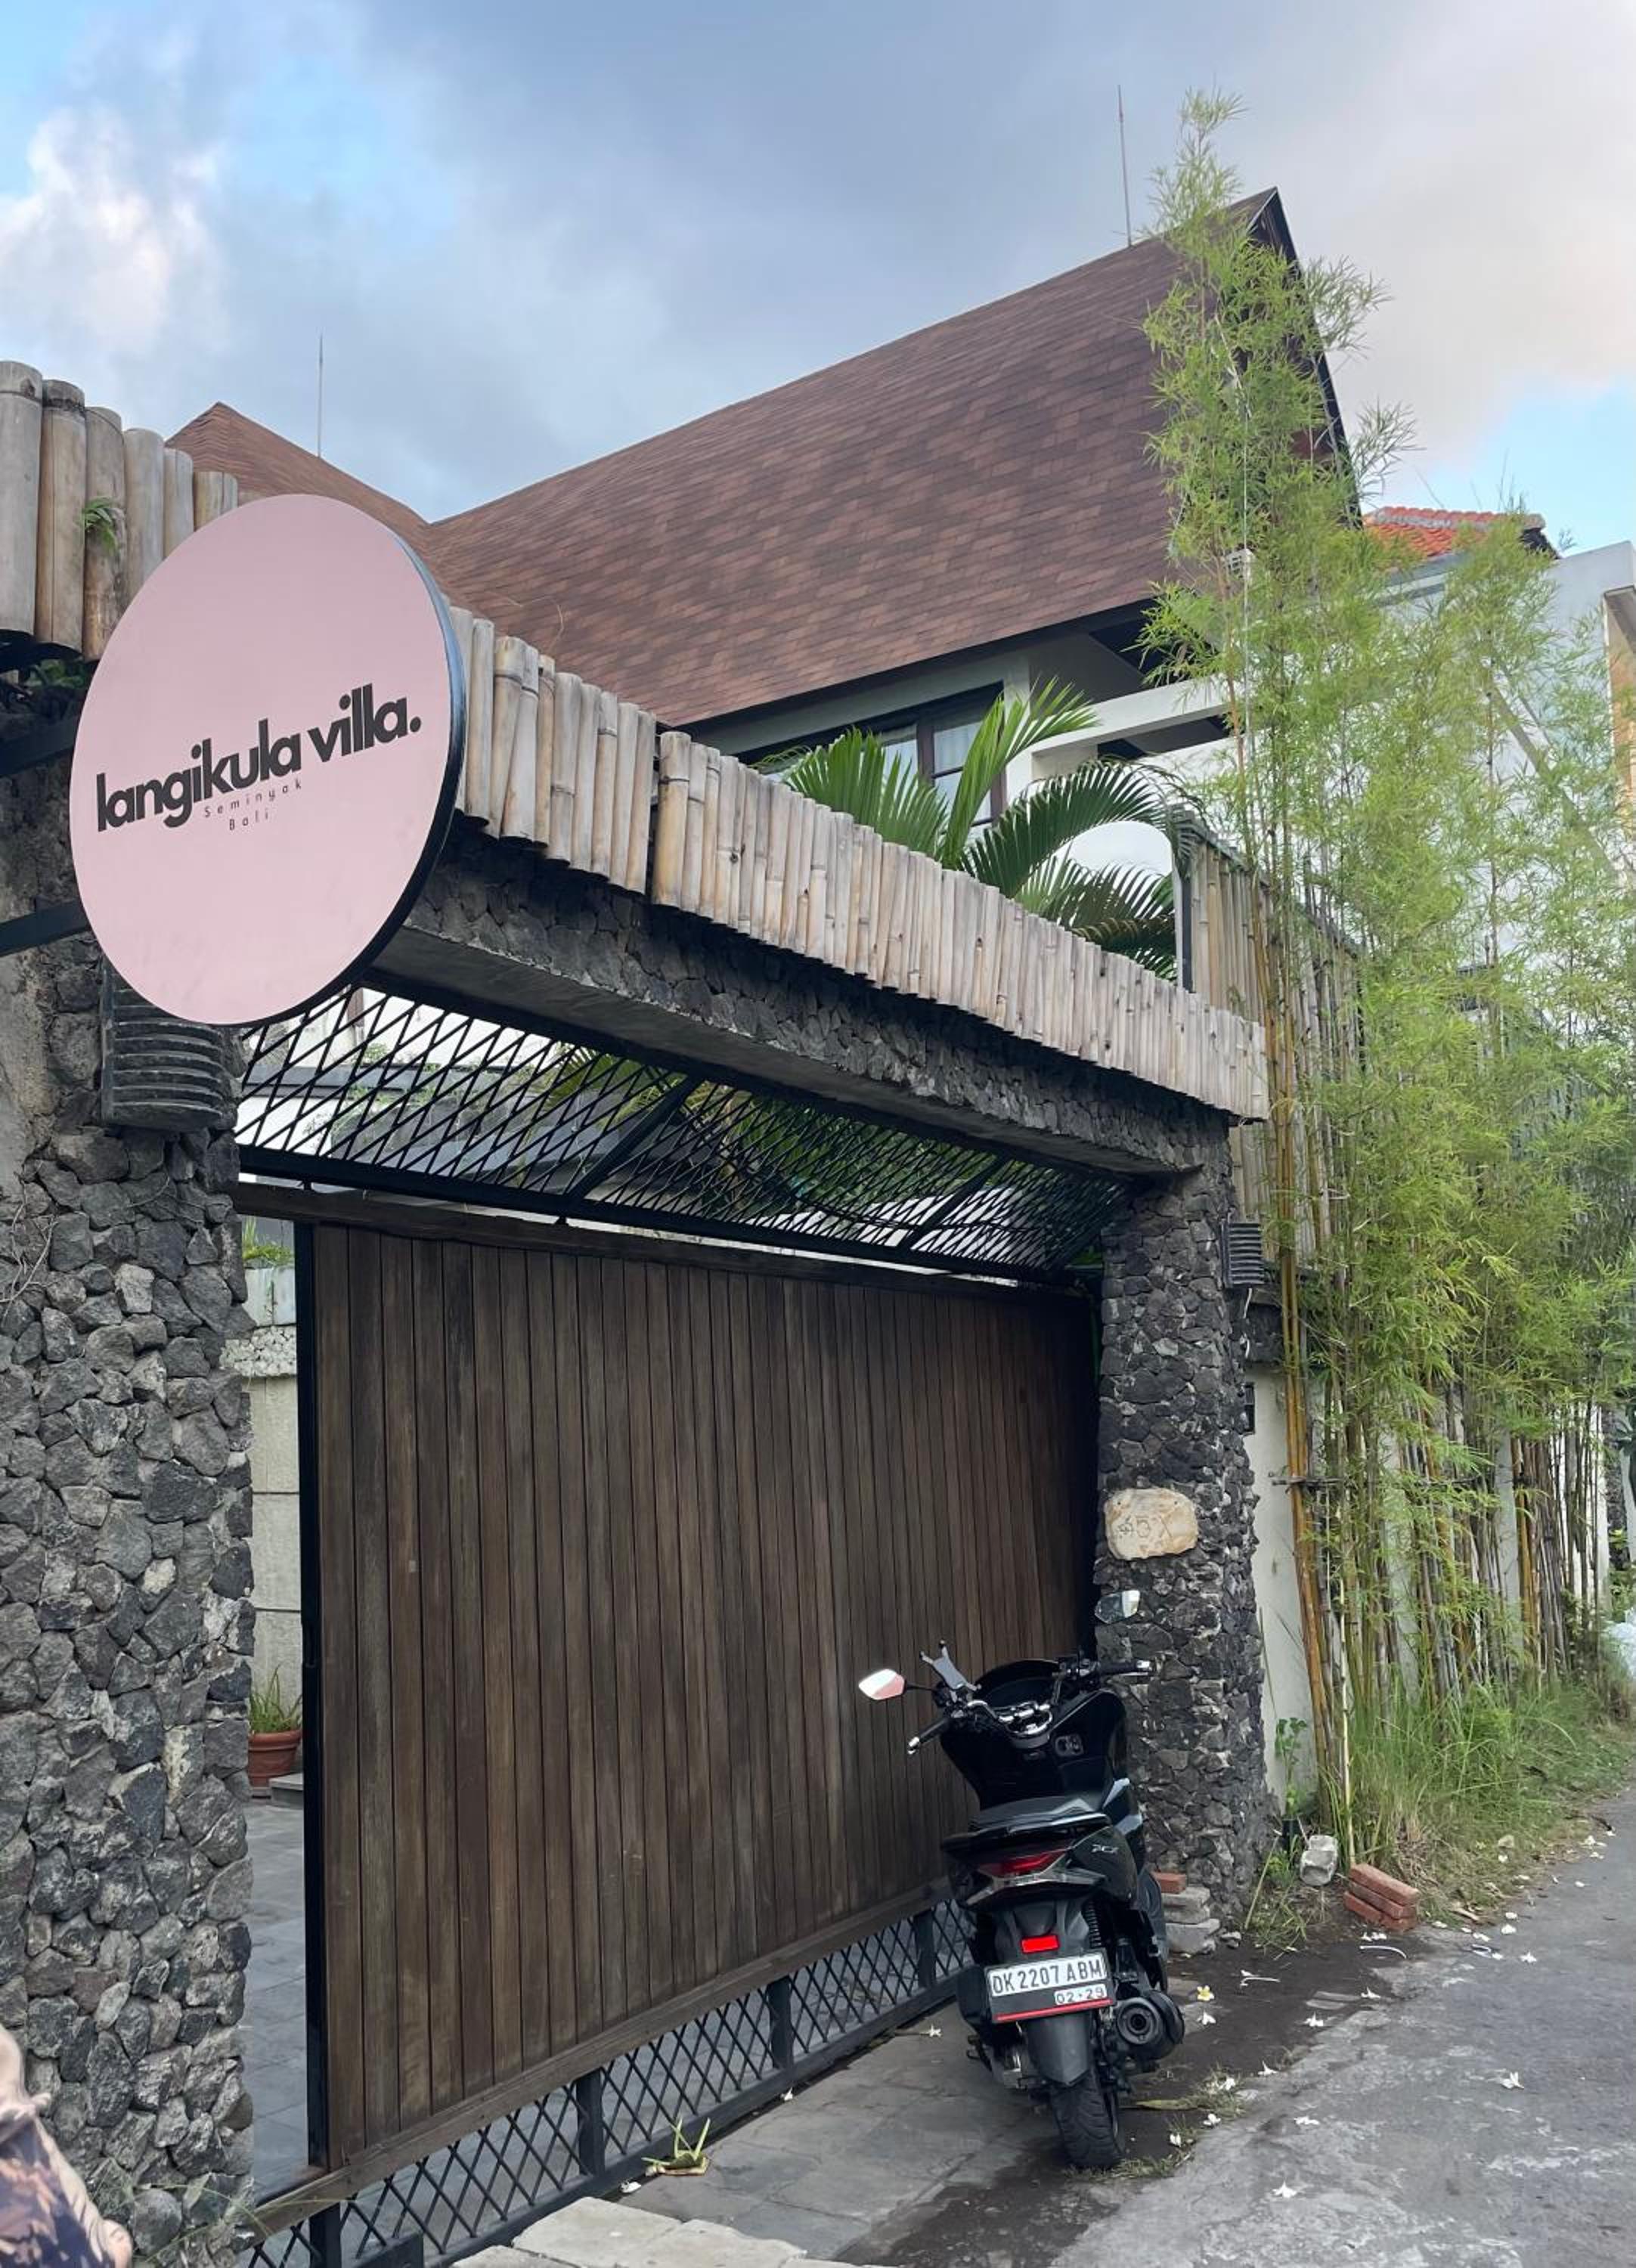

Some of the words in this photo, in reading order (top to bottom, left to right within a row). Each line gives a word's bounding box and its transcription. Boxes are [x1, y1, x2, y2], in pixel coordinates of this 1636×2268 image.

[96, 717, 301, 832] langikula
[308, 683, 422, 763] villa.
[204, 778, 302, 818] Seminyak
[229, 807, 268, 831] Bali
[993, 1972, 1015, 1994] DK
[1018, 1965, 1060, 1989] 2207
[1067, 1959, 1103, 1982] ABM
